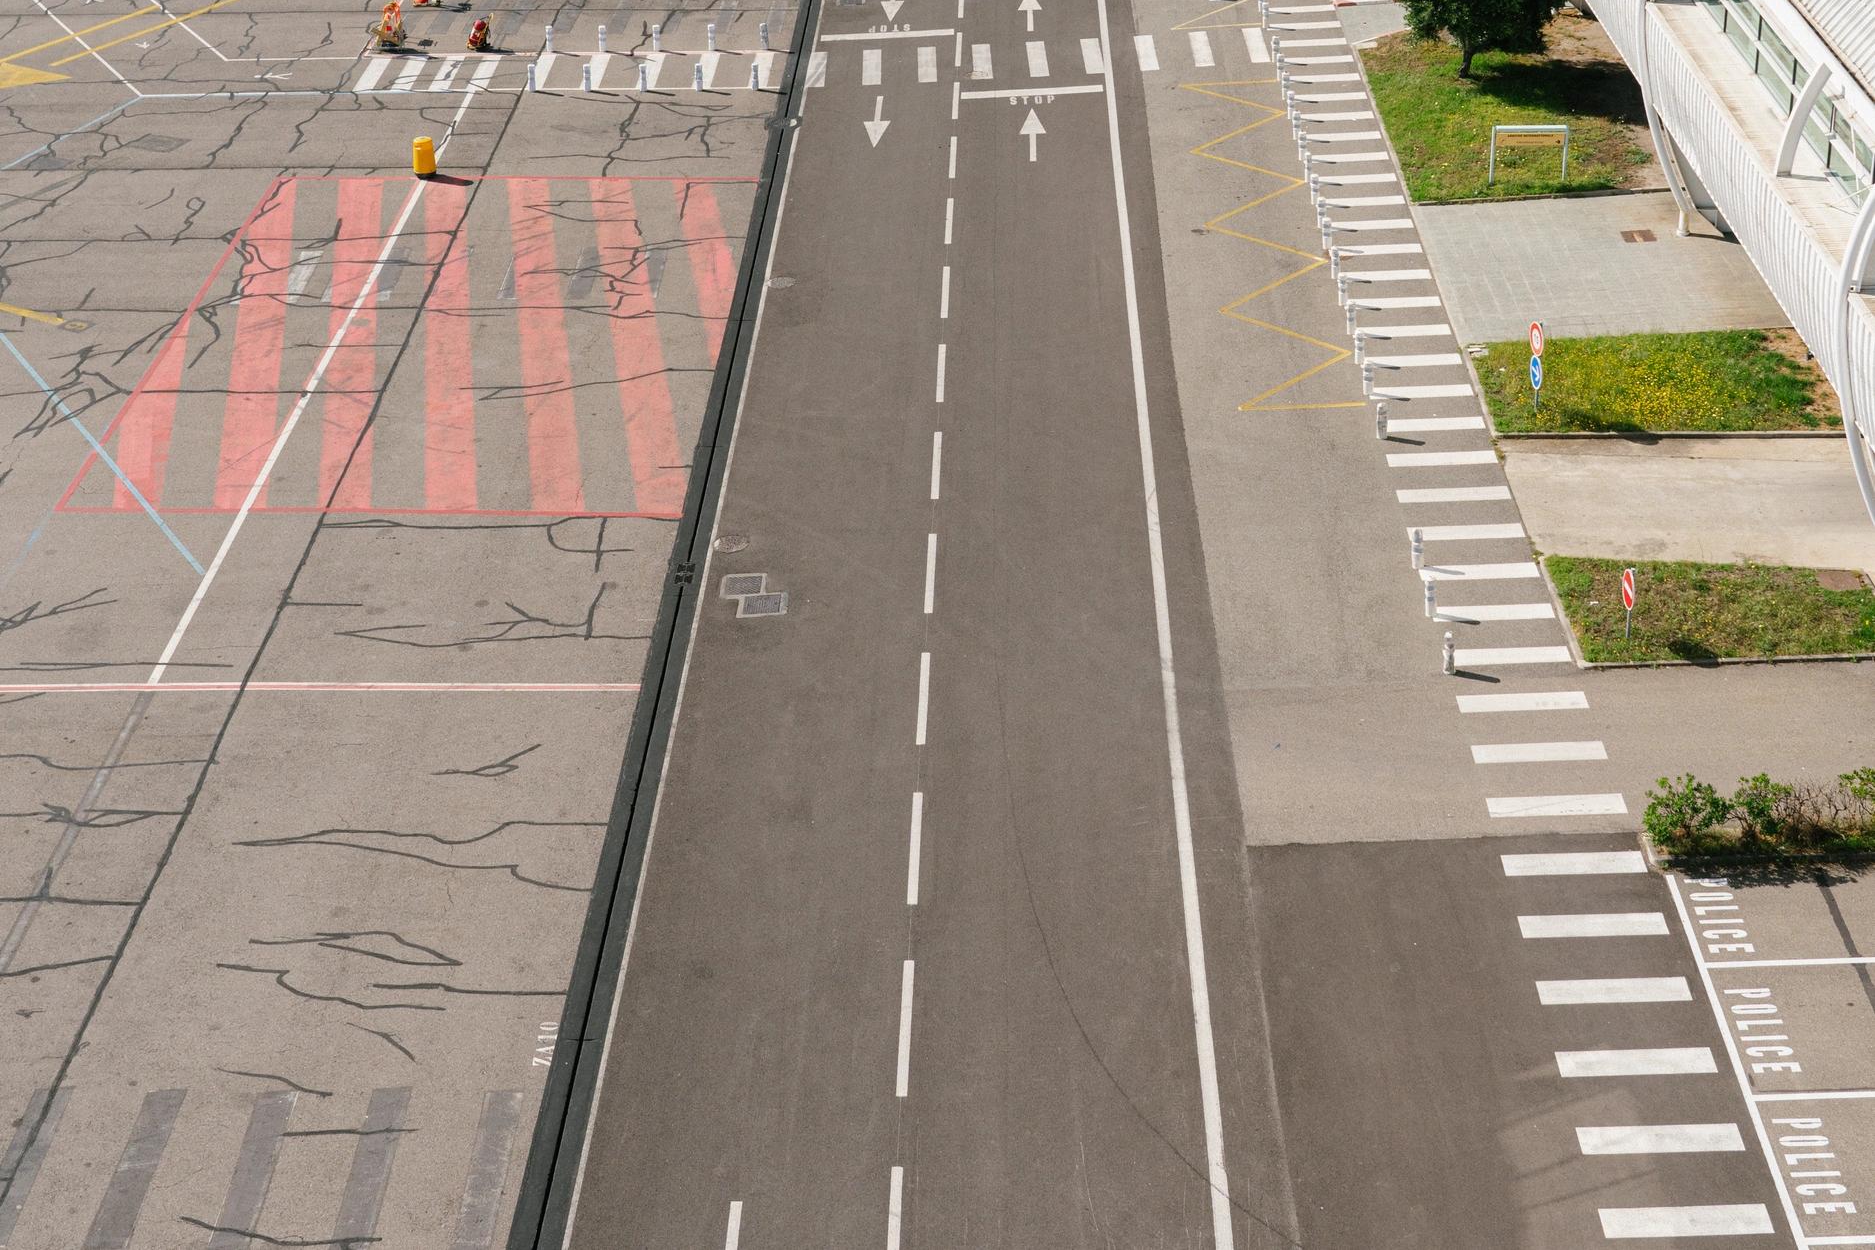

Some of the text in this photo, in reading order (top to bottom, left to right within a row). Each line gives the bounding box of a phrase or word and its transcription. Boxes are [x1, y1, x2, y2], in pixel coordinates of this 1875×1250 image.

[868, 23, 911, 34] STOP
[1009, 95, 1056, 106] STOP
[1684, 877, 1756, 955] POLICE
[1723, 987, 1802, 1074] POLICE
[1771, 1117, 1857, 1215] POLICE
